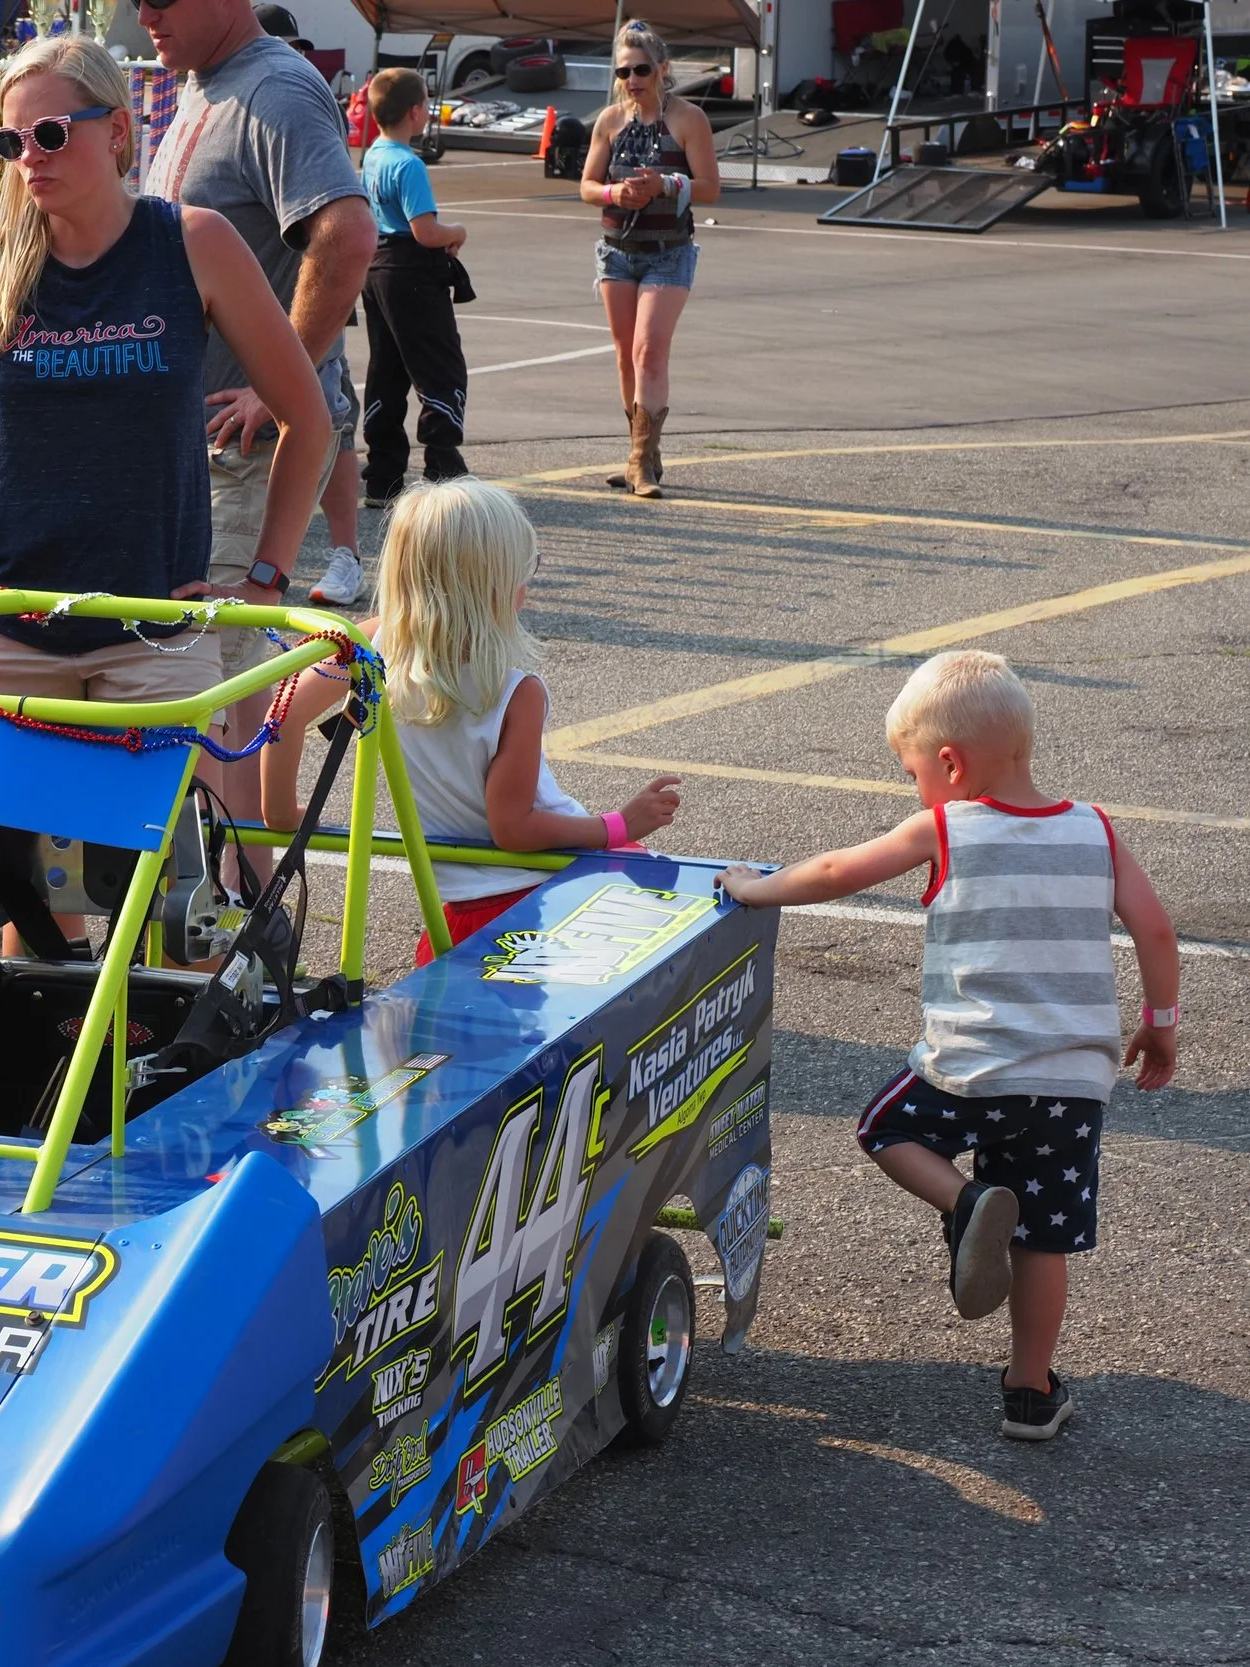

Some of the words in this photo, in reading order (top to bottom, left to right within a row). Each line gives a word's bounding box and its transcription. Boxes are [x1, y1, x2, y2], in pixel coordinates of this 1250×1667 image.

[3, 315, 166, 349] America
[13, 350, 34, 362] THE
[36, 341, 169, 378] BEAUTIFUL
[628, 1025, 688, 1101] Kasia
[694, 959, 756, 1044] Patryk
[649, 1024, 733, 1128] Ventures
[709, 1129, 738, 1161] MEDICAL
[738, 1107, 765, 1138] CENTER
[352, 1262, 440, 1369] TIRE
[374, 1352, 430, 1407] NIX'S
[377, 1392, 422, 1429] TRUCKING
[487, 1380, 562, 1459] HUDSONVILLE
[503, 1421, 555, 1478] TRAILER
